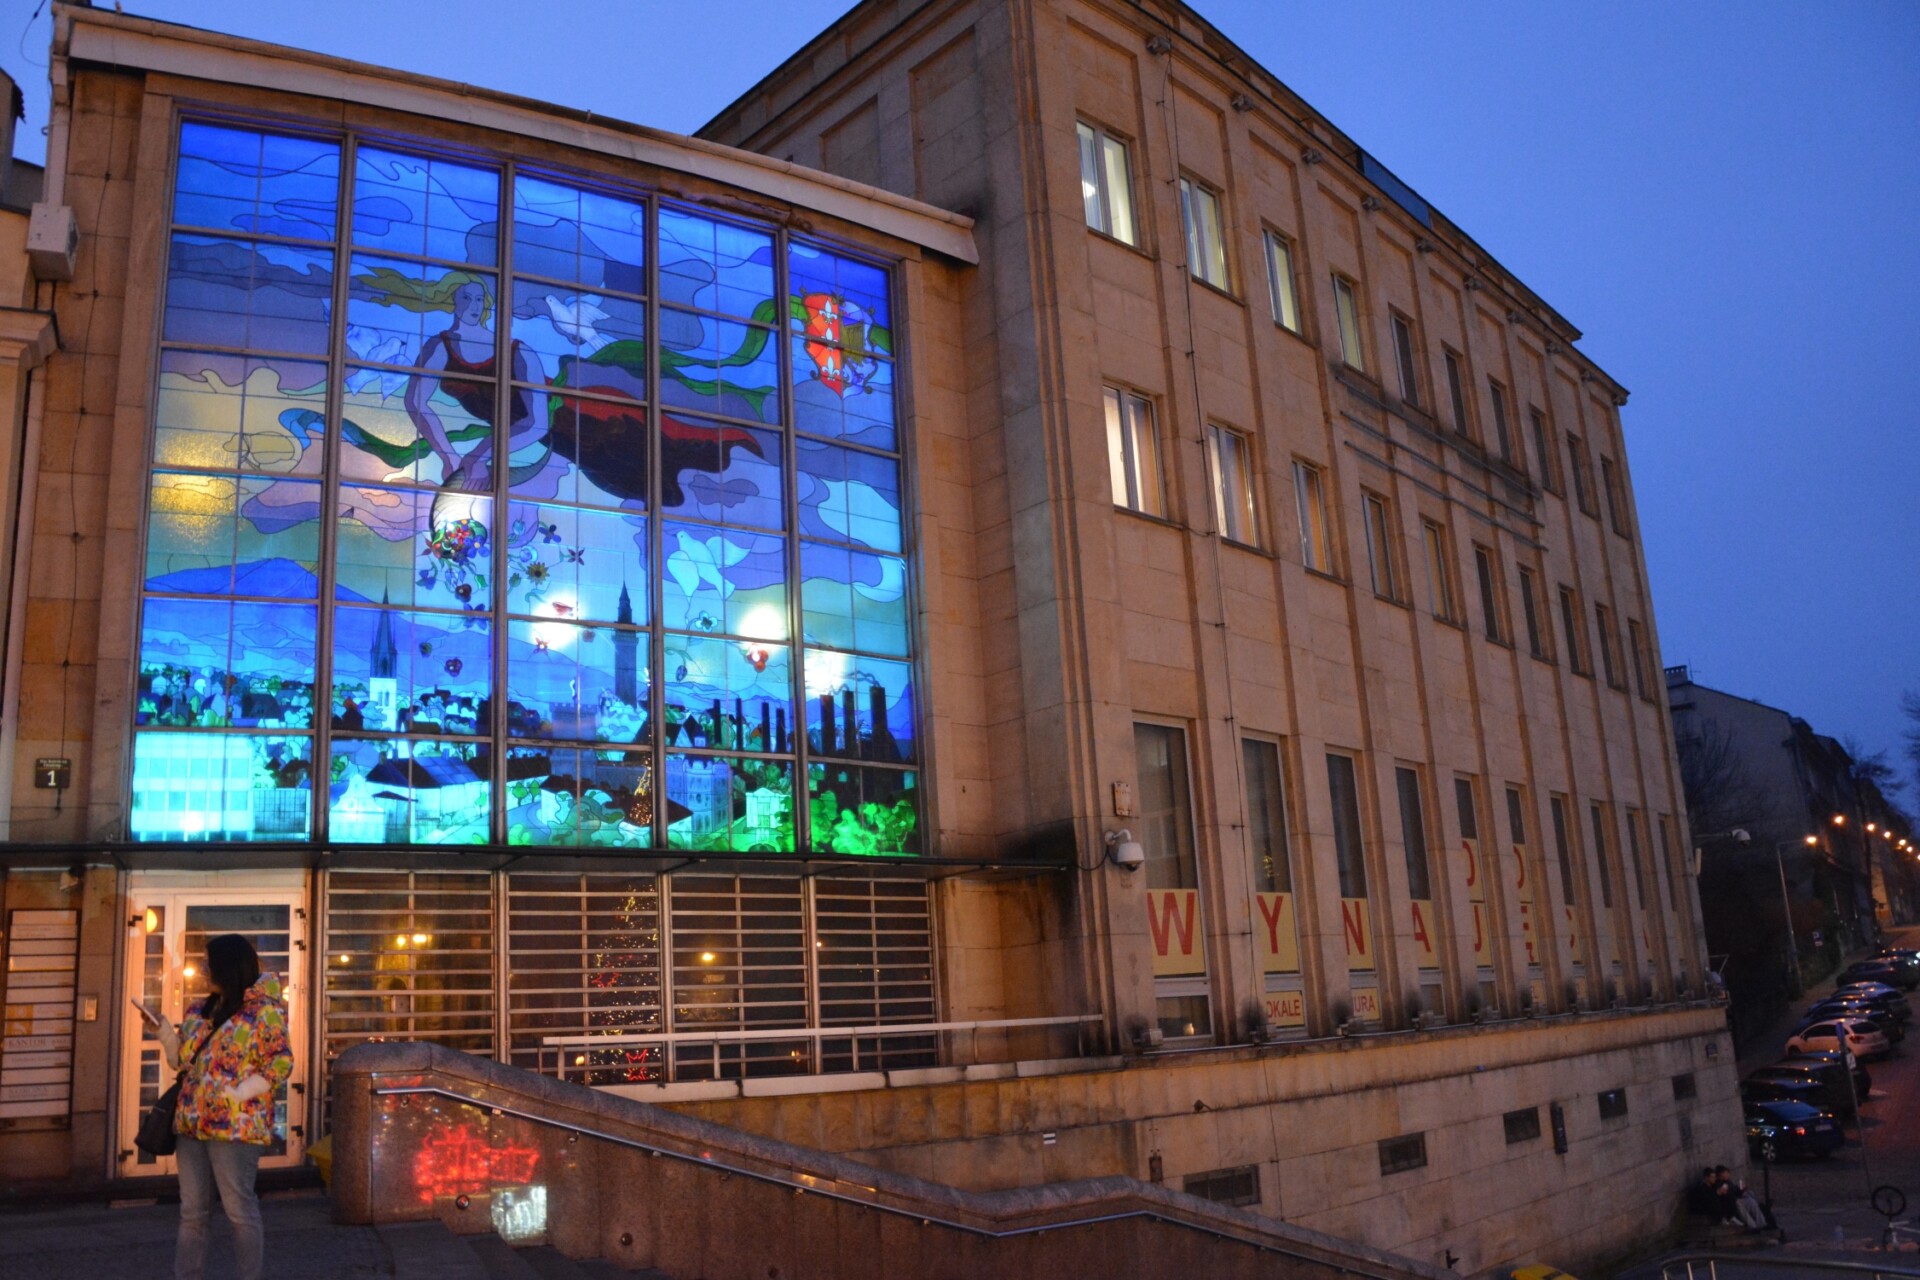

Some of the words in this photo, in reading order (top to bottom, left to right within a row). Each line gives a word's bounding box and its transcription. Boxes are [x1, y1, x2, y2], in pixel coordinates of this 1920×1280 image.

[47, 770, 56, 786] 1
[1266, 999, 1301, 1018] OKALE
[1353, 995, 1376, 1012] URA
